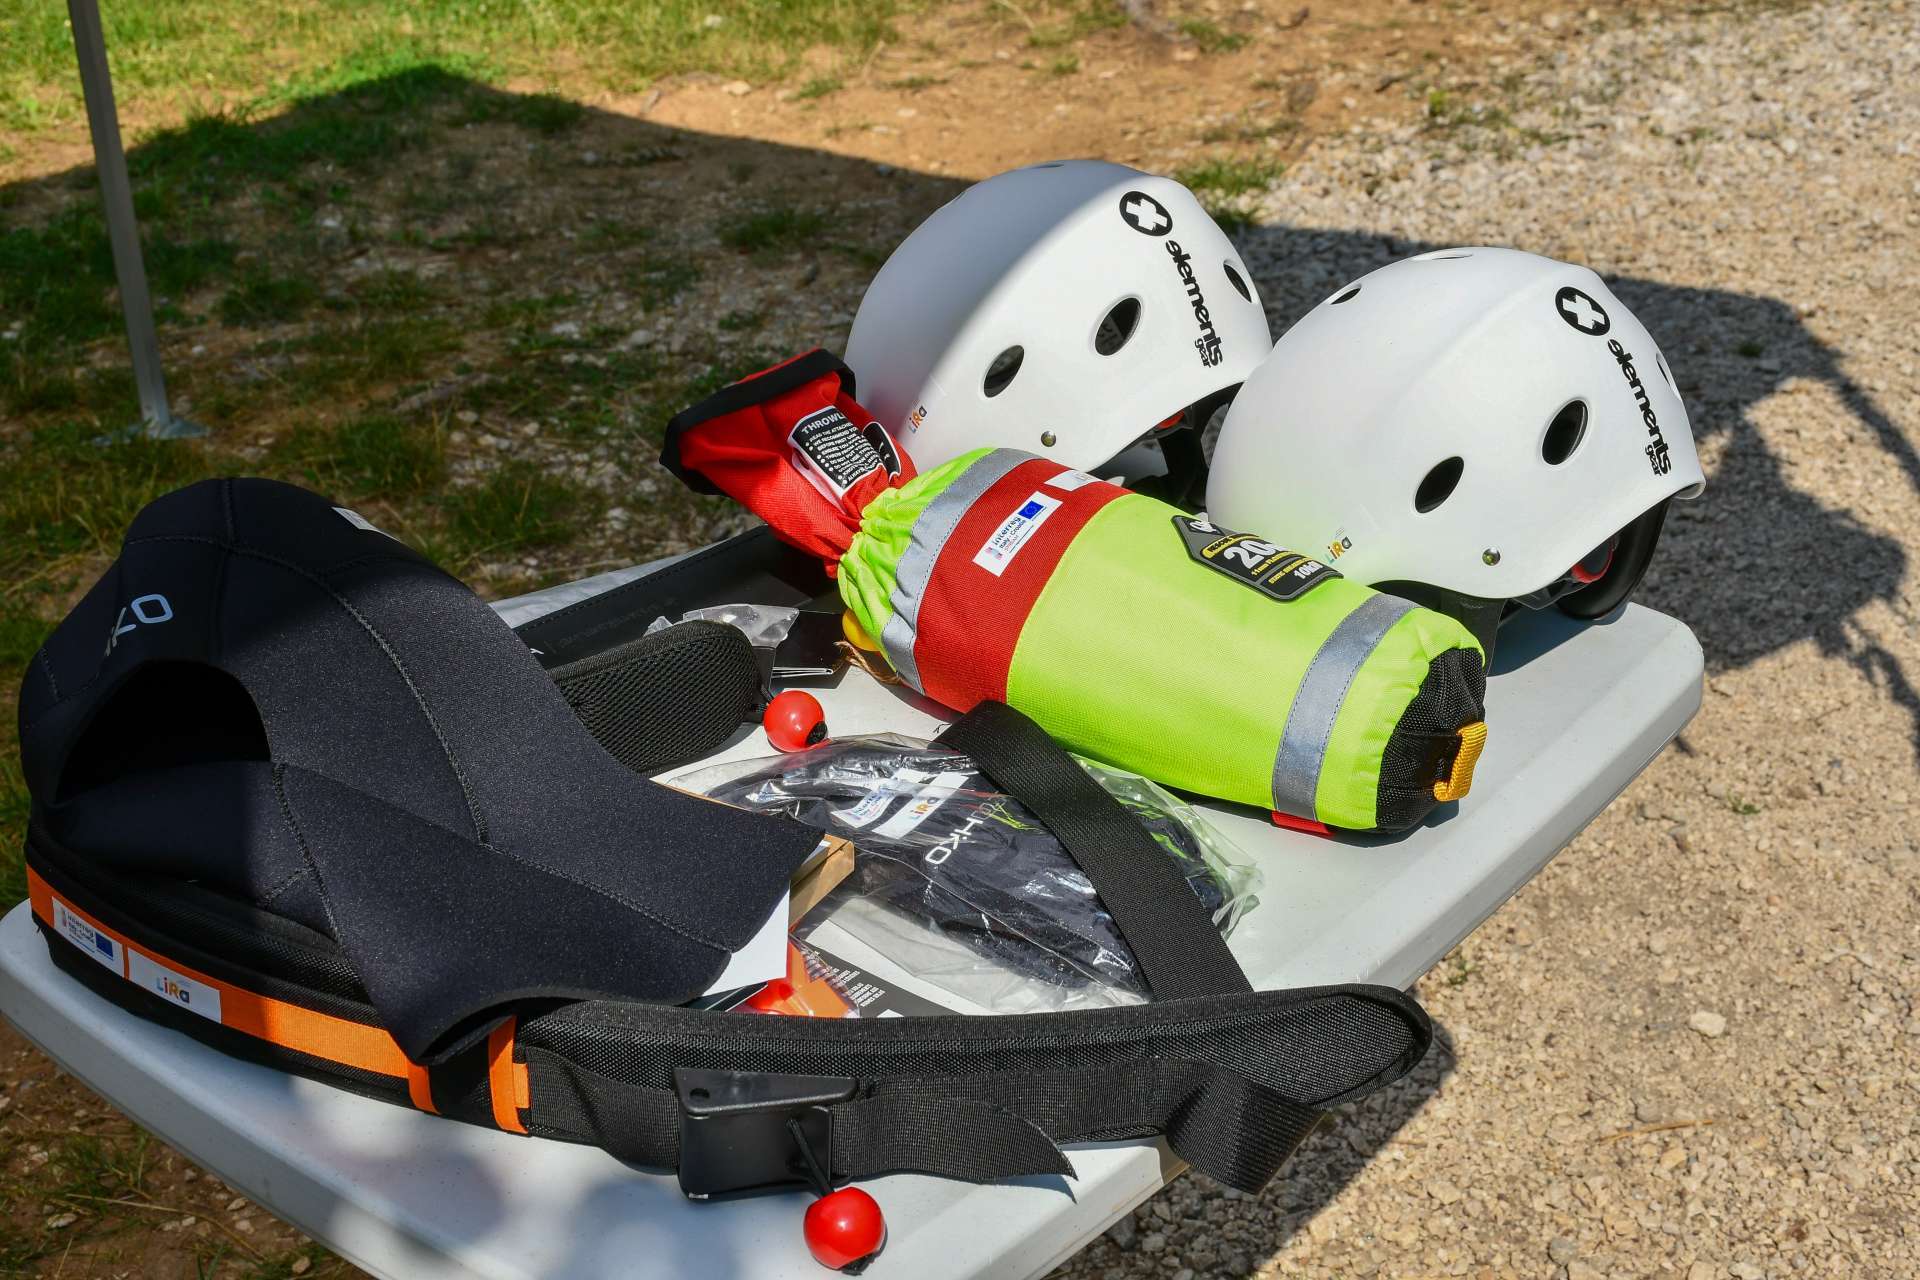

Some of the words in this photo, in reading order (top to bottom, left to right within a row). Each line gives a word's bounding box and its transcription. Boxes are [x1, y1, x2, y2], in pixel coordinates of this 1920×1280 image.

[1165, 240, 1224, 367] elements
[1194, 338, 1212, 368] gear
[1607, 338, 1672, 475] elements
[801, 412, 847, 434] THROWL
[1644, 444, 1662, 476] gear
[991, 516, 1021, 545] Interreg
[156, 976, 190, 1005] LiRa
